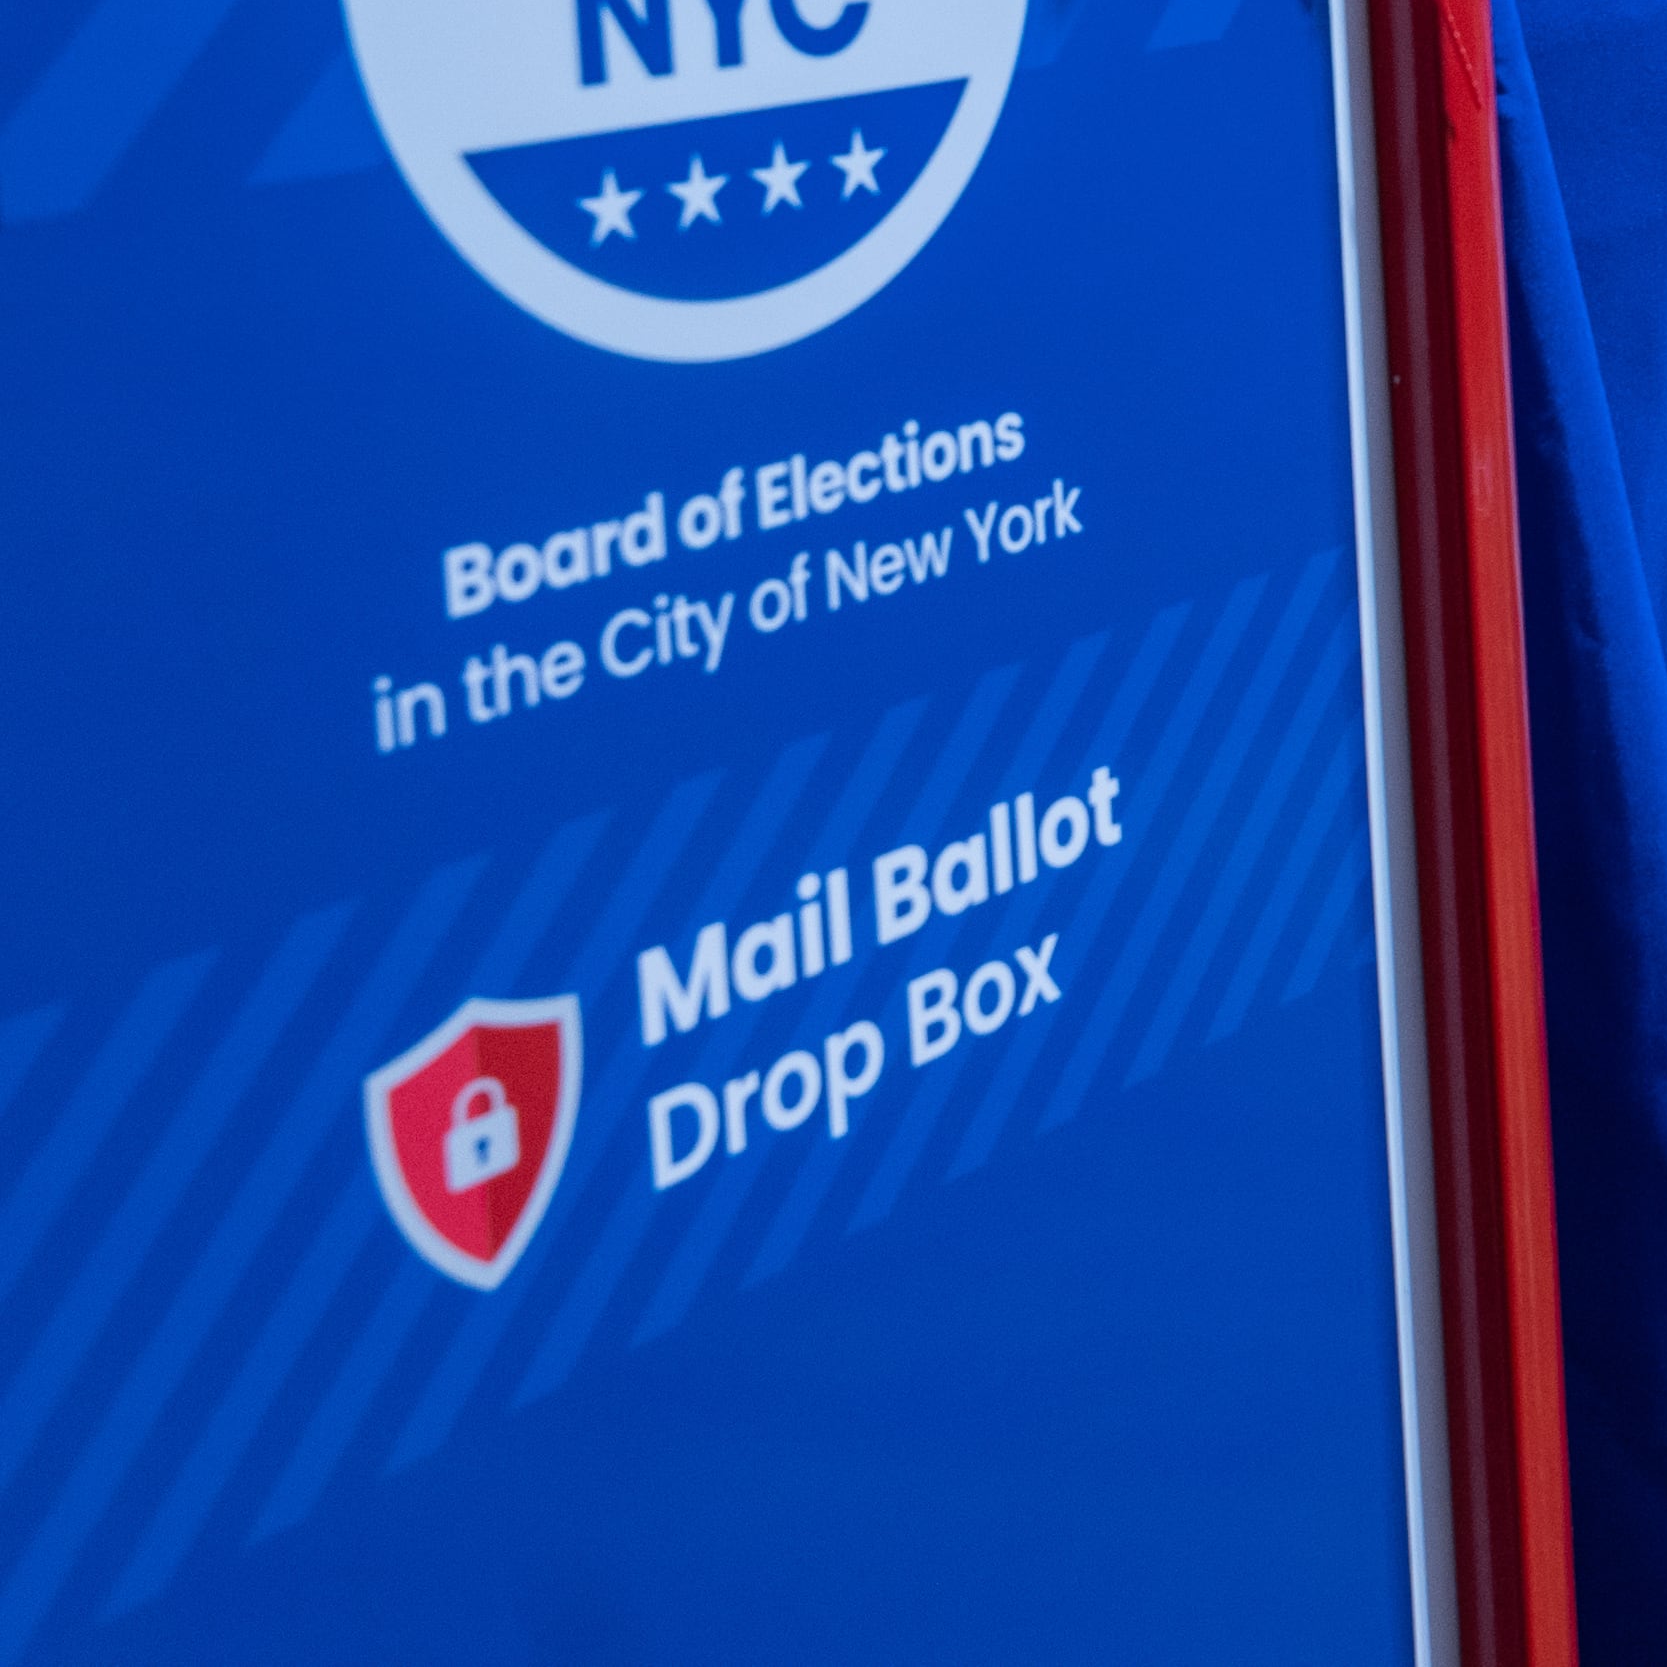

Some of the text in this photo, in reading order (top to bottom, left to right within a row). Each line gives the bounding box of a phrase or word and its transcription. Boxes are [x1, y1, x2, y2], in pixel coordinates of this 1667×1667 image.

[372, 479, 1084, 754] in the City of New York
[442, 411, 1026, 619] Board of Elections
[636, 765, 1124, 1048] Mail Ballot
[647, 933, 1063, 1192] Drop Box
